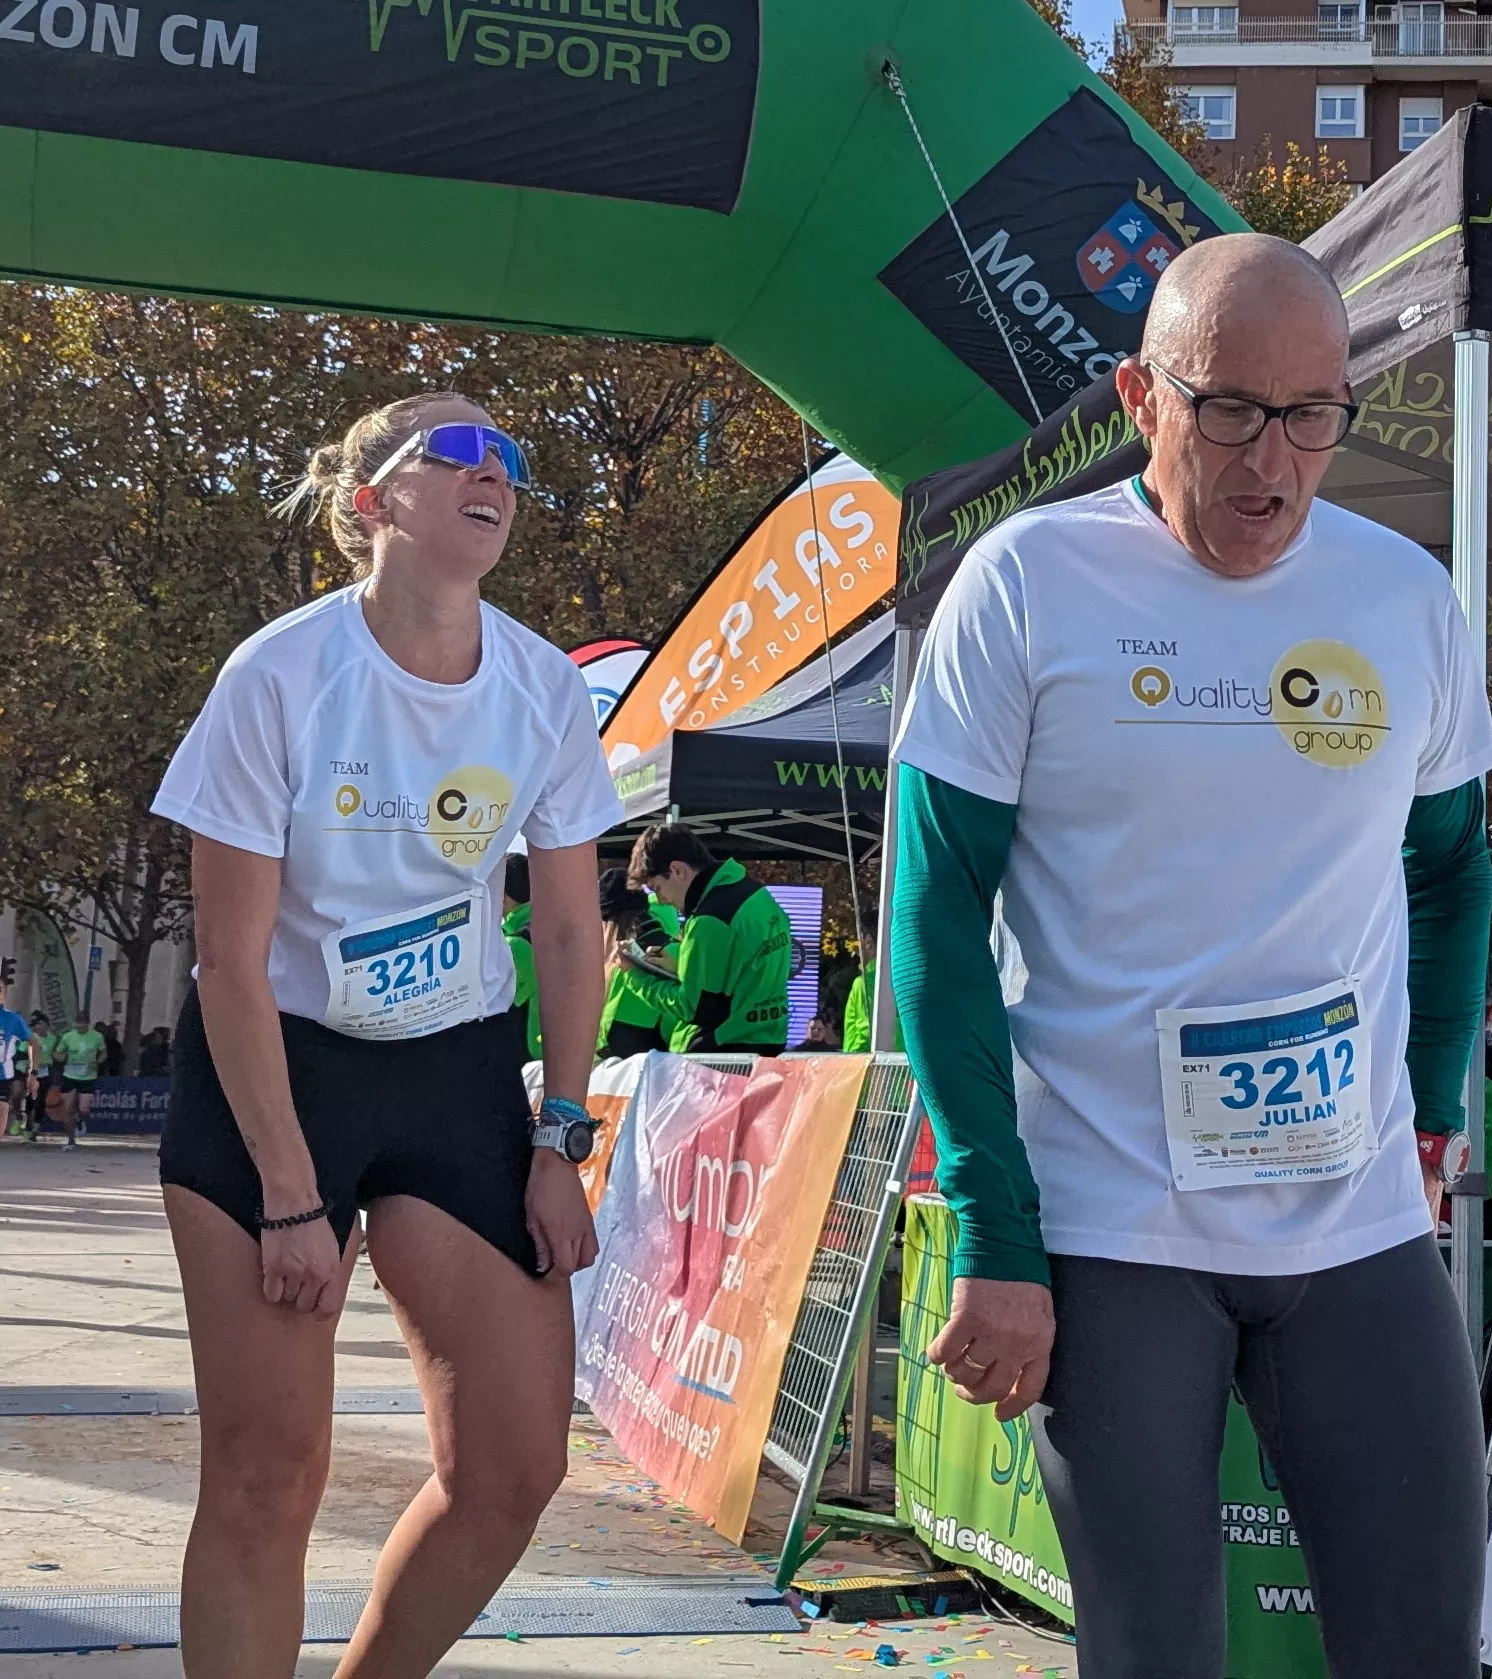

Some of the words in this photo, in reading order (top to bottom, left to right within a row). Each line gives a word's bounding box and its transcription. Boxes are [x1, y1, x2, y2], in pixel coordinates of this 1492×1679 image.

[159, 14, 259, 74] CM
[474, 24, 682, 87] SPORT
[658, 492, 874, 728] ESPIAS
[1117, 639, 1178, 656] TEAM
[1131, 666, 1272, 716] Quality
[1294, 730, 1372, 755] group
[330, 760, 370, 776] TEAM
[336, 784, 430, 827] Quality
[366, 934, 461, 996] 3210
[383, 977, 442, 1007] ALEGRÍA
[1183, 1064, 1210, 1073] EX71
[1218, 1038, 1355, 1110] 3212
[1259, 1099, 1337, 1127] JULIAN
[1254, 1169, 1293, 1179] QUALITY
[1297, 1166, 1323, 1176] CORN
[1325, 1159, 1349, 1174] GROUP
